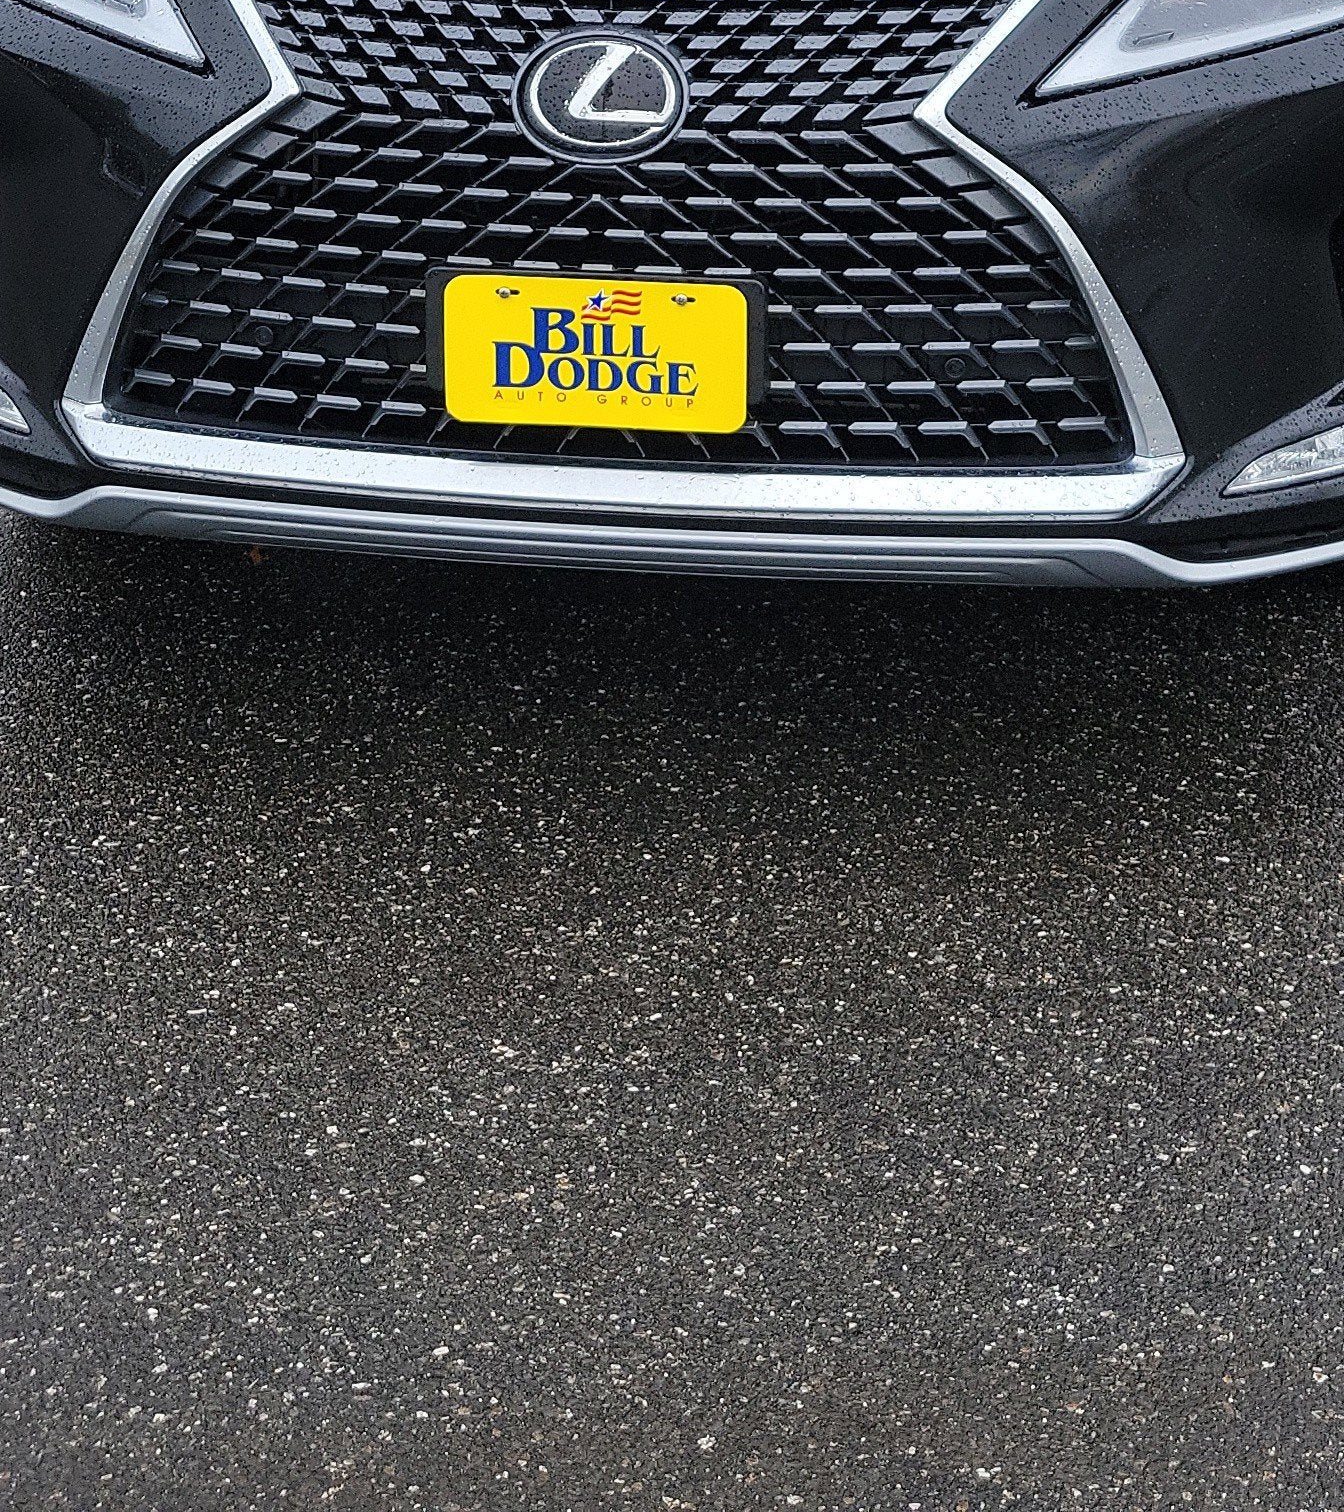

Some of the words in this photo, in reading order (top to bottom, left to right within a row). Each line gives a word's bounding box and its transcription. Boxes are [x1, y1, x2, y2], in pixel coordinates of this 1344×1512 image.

[530, 306, 661, 359] BILL
[491, 341, 699, 396] DODGE
[494, 389, 567, 403] AUTO
[596, 394, 694, 408] GROUP
